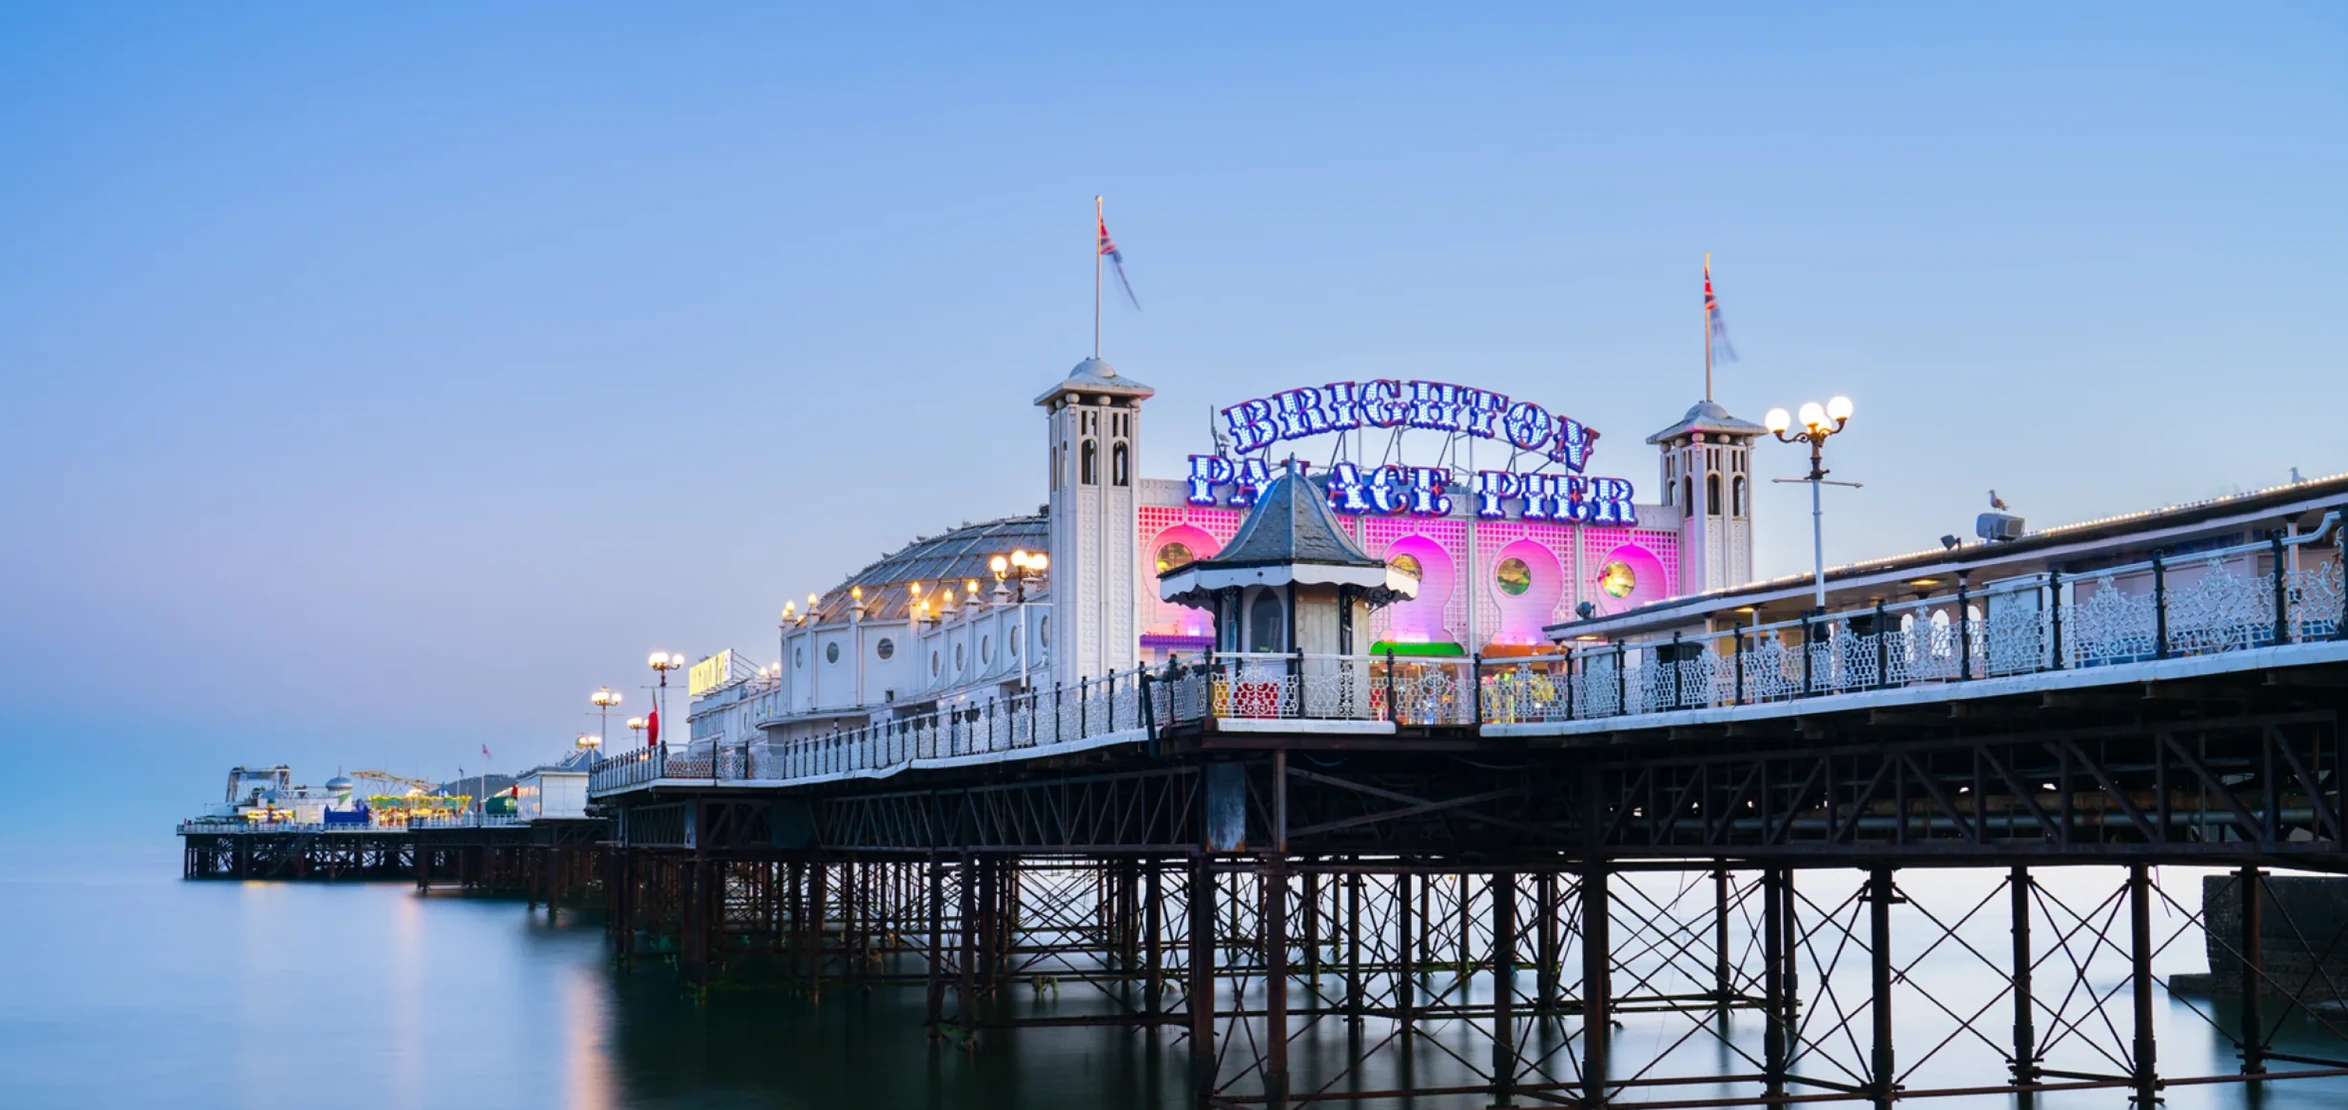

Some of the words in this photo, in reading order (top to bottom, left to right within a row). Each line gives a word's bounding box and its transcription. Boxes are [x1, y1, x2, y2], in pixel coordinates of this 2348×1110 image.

[1221, 378, 1600, 474] BRIGHTON
[1187, 453, 1453, 517] PAACE
[1478, 468, 1640, 527] PIER
